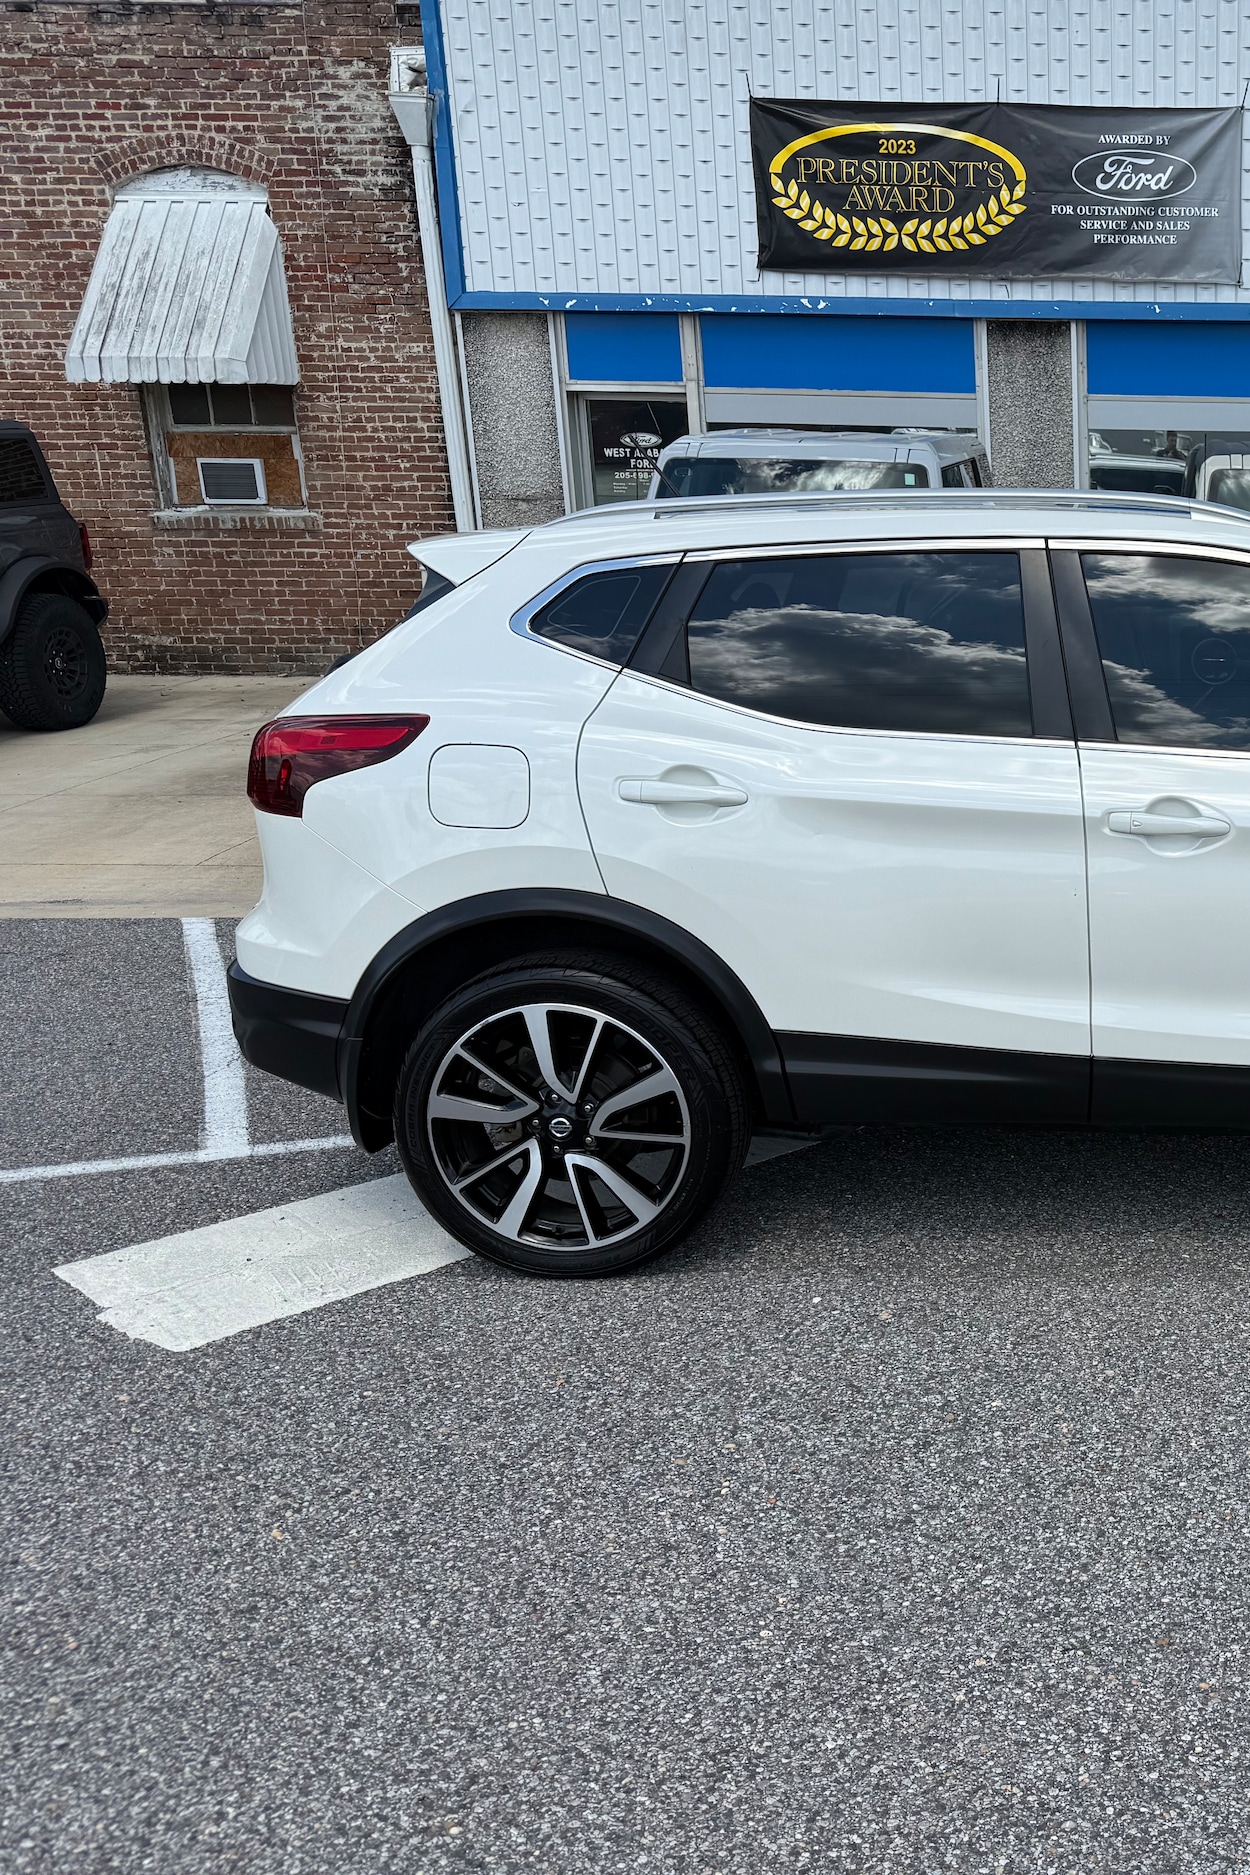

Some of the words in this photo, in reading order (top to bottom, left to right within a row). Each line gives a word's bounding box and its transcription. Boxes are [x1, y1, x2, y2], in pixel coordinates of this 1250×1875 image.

[1098, 134, 1153, 145] AWARDED
[1155, 135, 1171, 145] BY
[878, 138, 917, 155] 2023
[796, 157, 1005, 188] PRESIDENT'S
[1096, 155, 1174, 191] Ford
[842, 185, 956, 213] AWARD
[1051, 205, 1074, 215] FOR
[1076, 205, 1155, 216] OUTSTANDING
[1158, 207, 1219, 217] CUSTOMER
[1080, 220, 1128, 231] SERVICE
[1130, 221, 1154, 231] AND
[1156, 221, 1190, 231] SALES
[1093, 234, 1177, 245] PERFORMANCE
[603, 447, 631, 458] WEST
